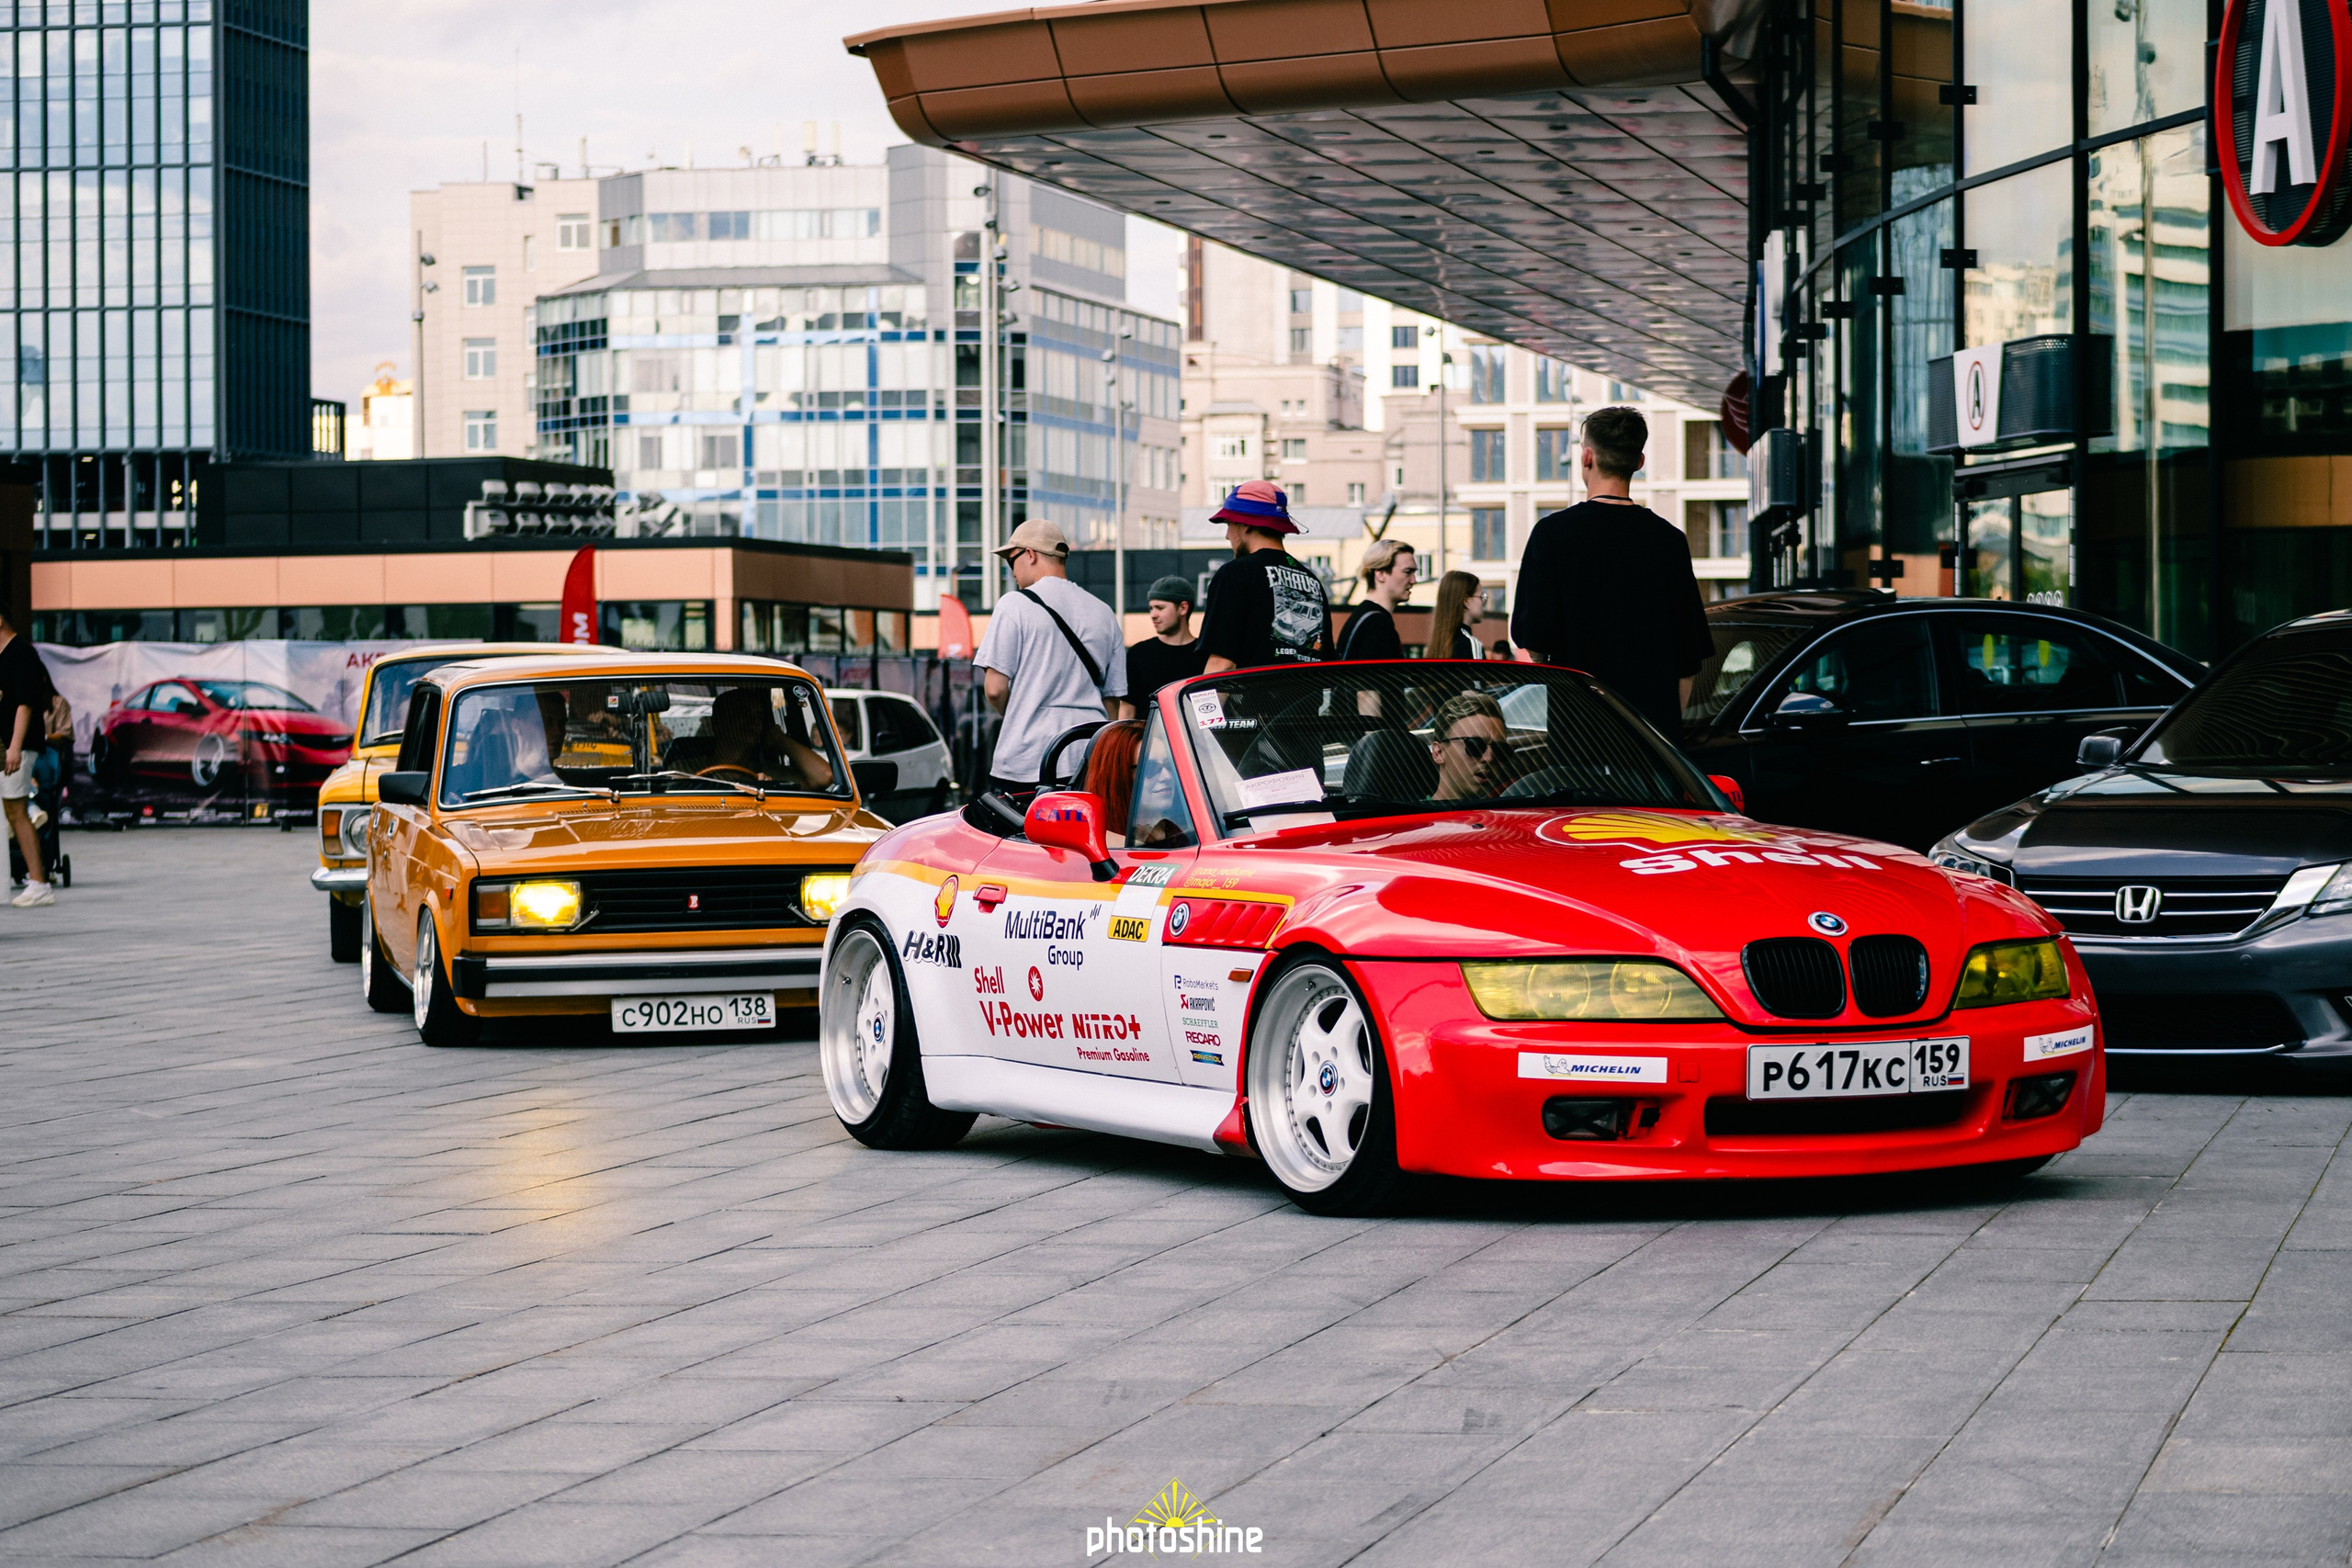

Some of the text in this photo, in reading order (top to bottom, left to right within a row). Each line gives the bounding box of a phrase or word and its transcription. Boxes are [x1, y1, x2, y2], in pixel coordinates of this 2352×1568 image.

[1264, 566, 1323, 598] EXHAUS
[1199, 716, 1224, 727] 177
[1228, 720, 1255, 728] TEAM
[1245, 773, 1305, 789] АКРОФОБИЯ
[1619, 849, 1883, 875] Shell
[1127, 865, 1176, 885] DEKRA
[1004, 910, 1087, 940] MultiBank
[1113, 919, 1144, 940] ADAC
[1047, 945, 1084, 970] Group
[974, 965, 1005, 994] Shell
[1182, 977, 1218, 991] RoboMarkets
[729, 997, 766, 1017] 138
[979, 1000, 1064, 1039] V-Power
[1182, 1017, 1218, 1029] SCHAEFFLER
[1185, 1031, 1221, 1047] RECARO
[2053, 1036, 2086, 1049] MICHELIN
[1076, 1046, 1150, 1062] Premium Gasoline
[1914, 1043, 1961, 1075] 159
[1571, 1065, 1642, 1075] MICHELIN
[1922, 1075, 1947, 1087] RUS
